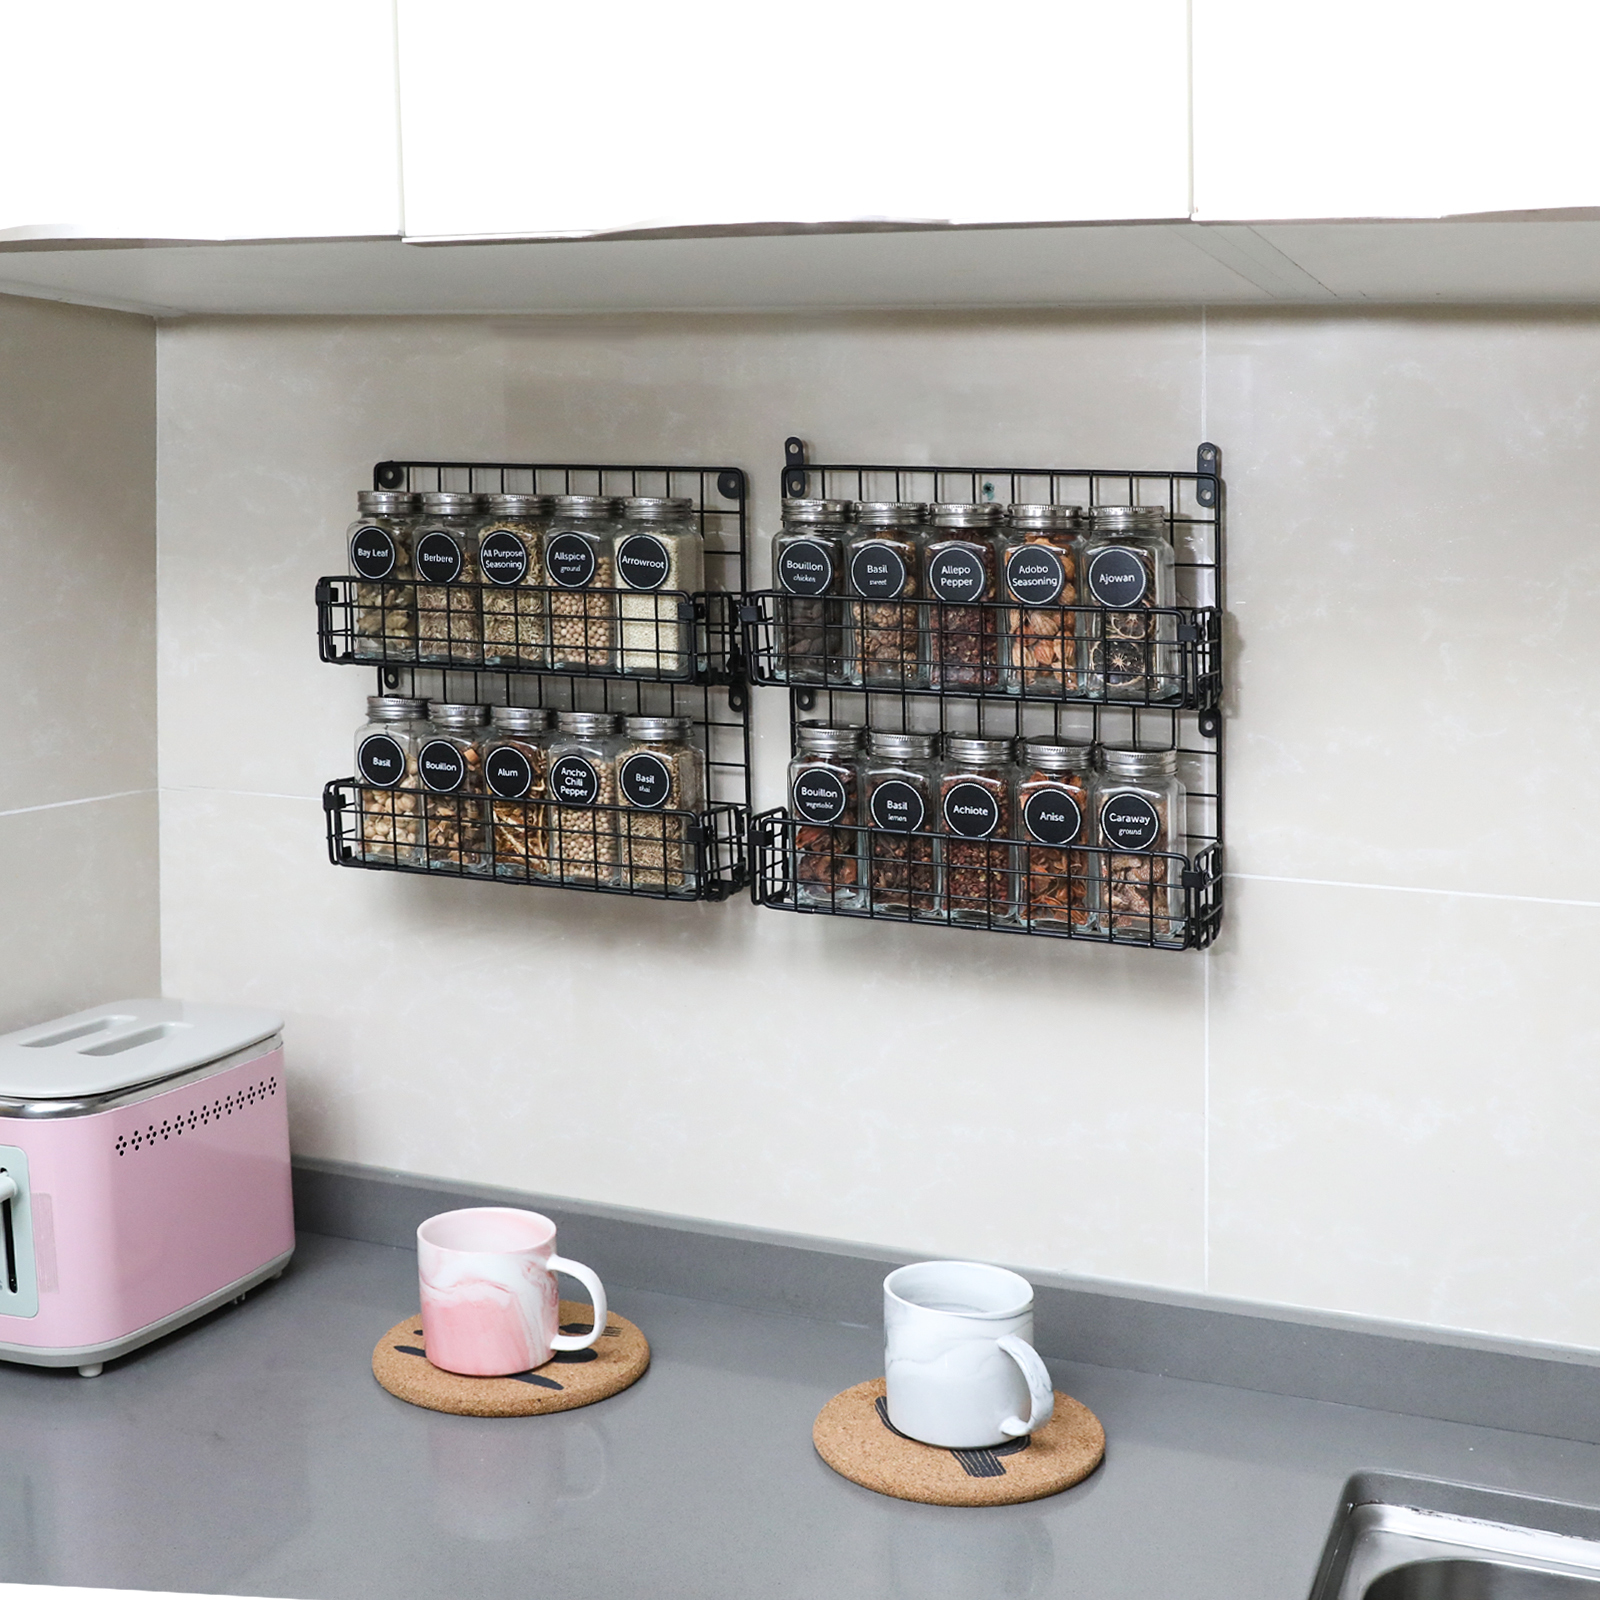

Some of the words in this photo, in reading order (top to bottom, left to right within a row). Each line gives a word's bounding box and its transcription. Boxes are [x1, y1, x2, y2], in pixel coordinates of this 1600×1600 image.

[358, 548, 371, 558] Bay
[372, 549, 388, 557] Leaf
[424, 553, 453, 563] Berbere
[483, 549, 492, 557] All
[493, 549, 523, 559] Purpose
[554, 552, 586, 562] Allspice
[485, 560, 522, 570] Seasoning
[621, 555, 665, 569] Arrowroot
[786, 560, 823, 571] Bouillon
[867, 565, 888, 573] Basil
[941, 565, 971, 576] Allepo
[1019, 565, 1049, 574] Adobo
[940, 578, 973, 588] Pepper
[1012, 576, 1058, 587] Seasoning
[1099, 573, 1135, 585] Ajowan
[372, 757, 391, 768] Basil
[425, 760, 457, 772] Bouillon
[497, 768, 518, 777] Alum
[561, 767, 587, 778] Ancho
[565, 777, 583, 786] Chili
[635, 773, 655, 784] Basil
[560, 786, 588, 797] Pepper
[801, 786, 838, 798] Bouillon
[887, 800, 908, 811] Basil
[953, 805, 989, 816] Achiote
[1039, 811, 1065, 822] Anise
[1109, 812, 1151, 826] Caraway
